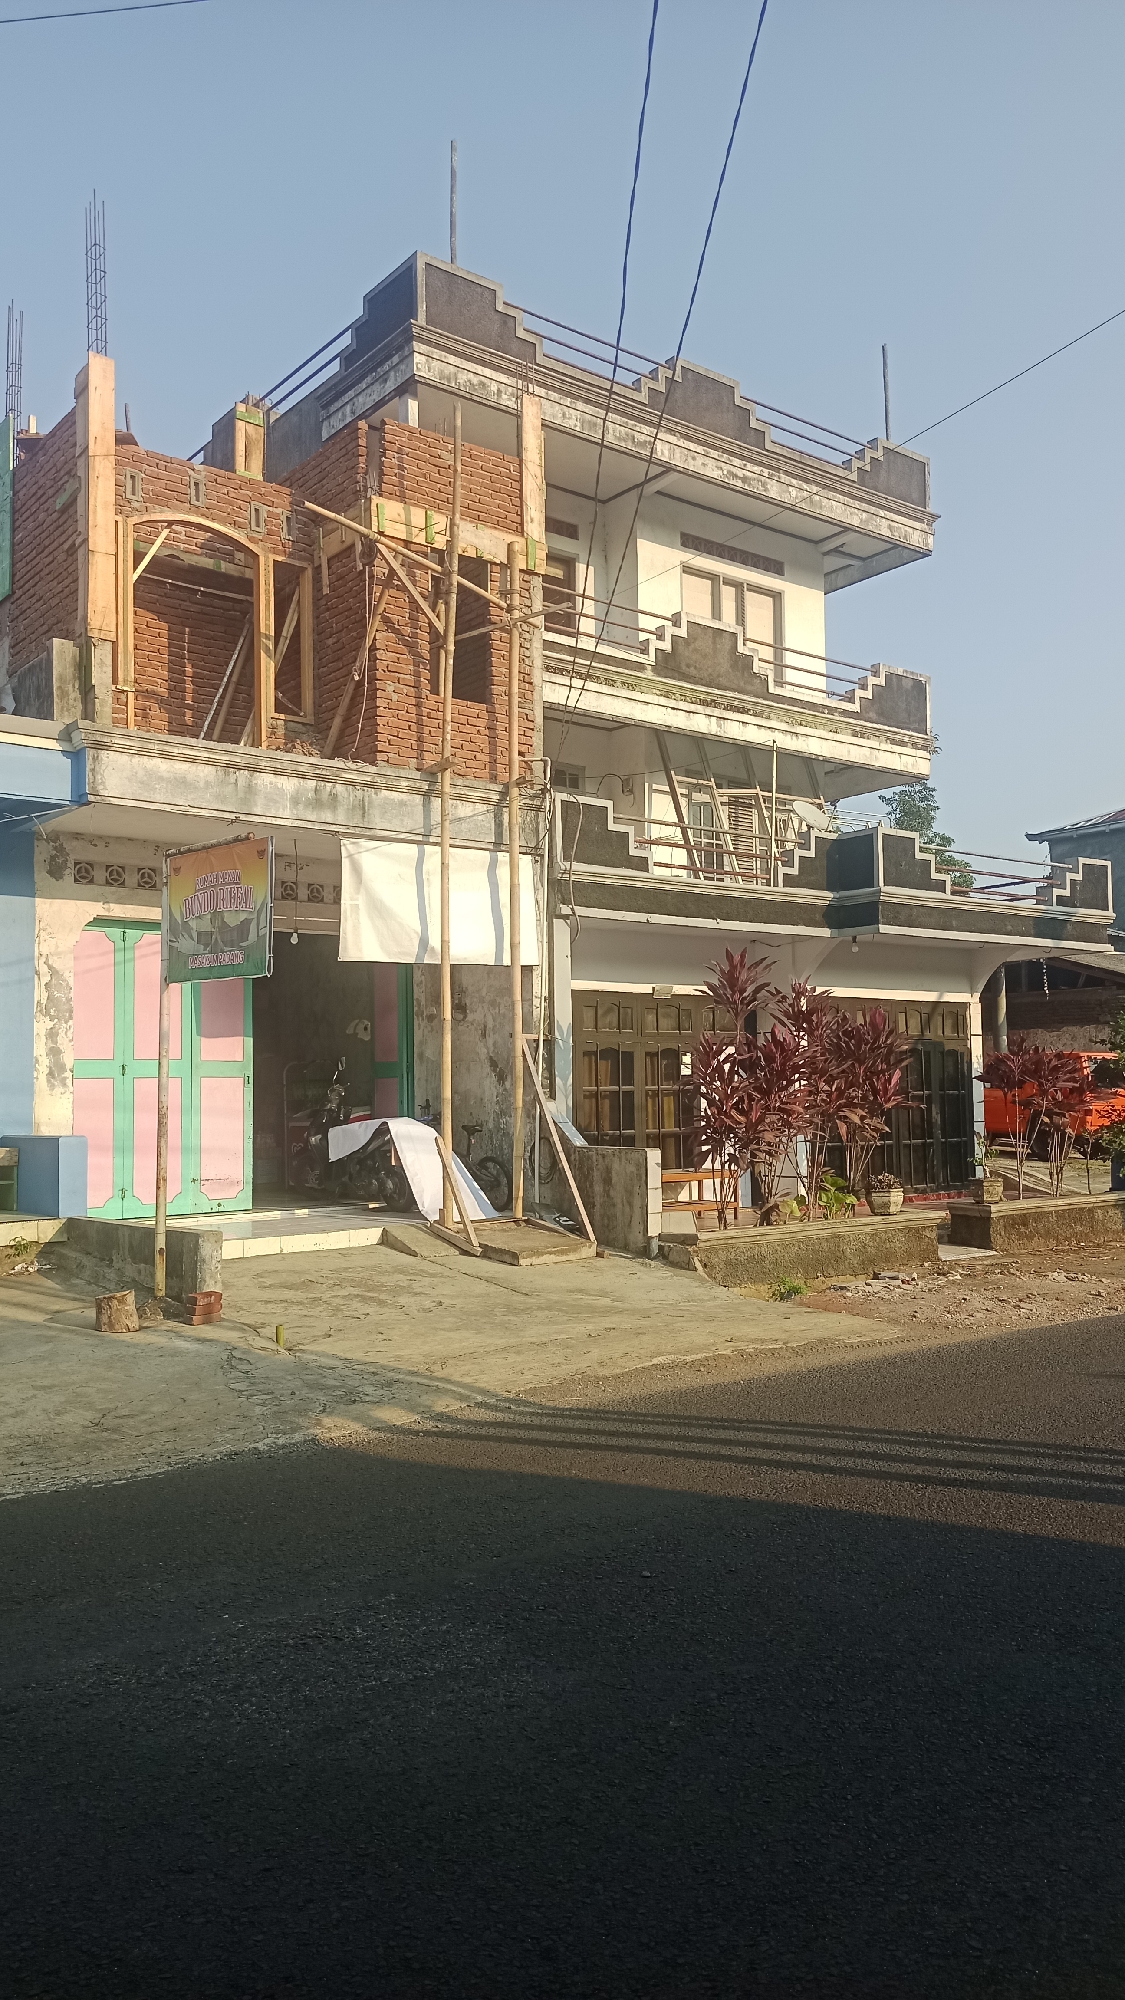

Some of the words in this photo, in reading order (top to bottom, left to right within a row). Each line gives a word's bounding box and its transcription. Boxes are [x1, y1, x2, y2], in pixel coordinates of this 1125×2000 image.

[196, 872, 217, 889] RUMAH
[218, 870, 241, 884] MAKAN
[184, 888, 215, 920] BUNDO
[189, 953, 218, 969] MASAKAN
[218, 951, 244, 966] PADANG
